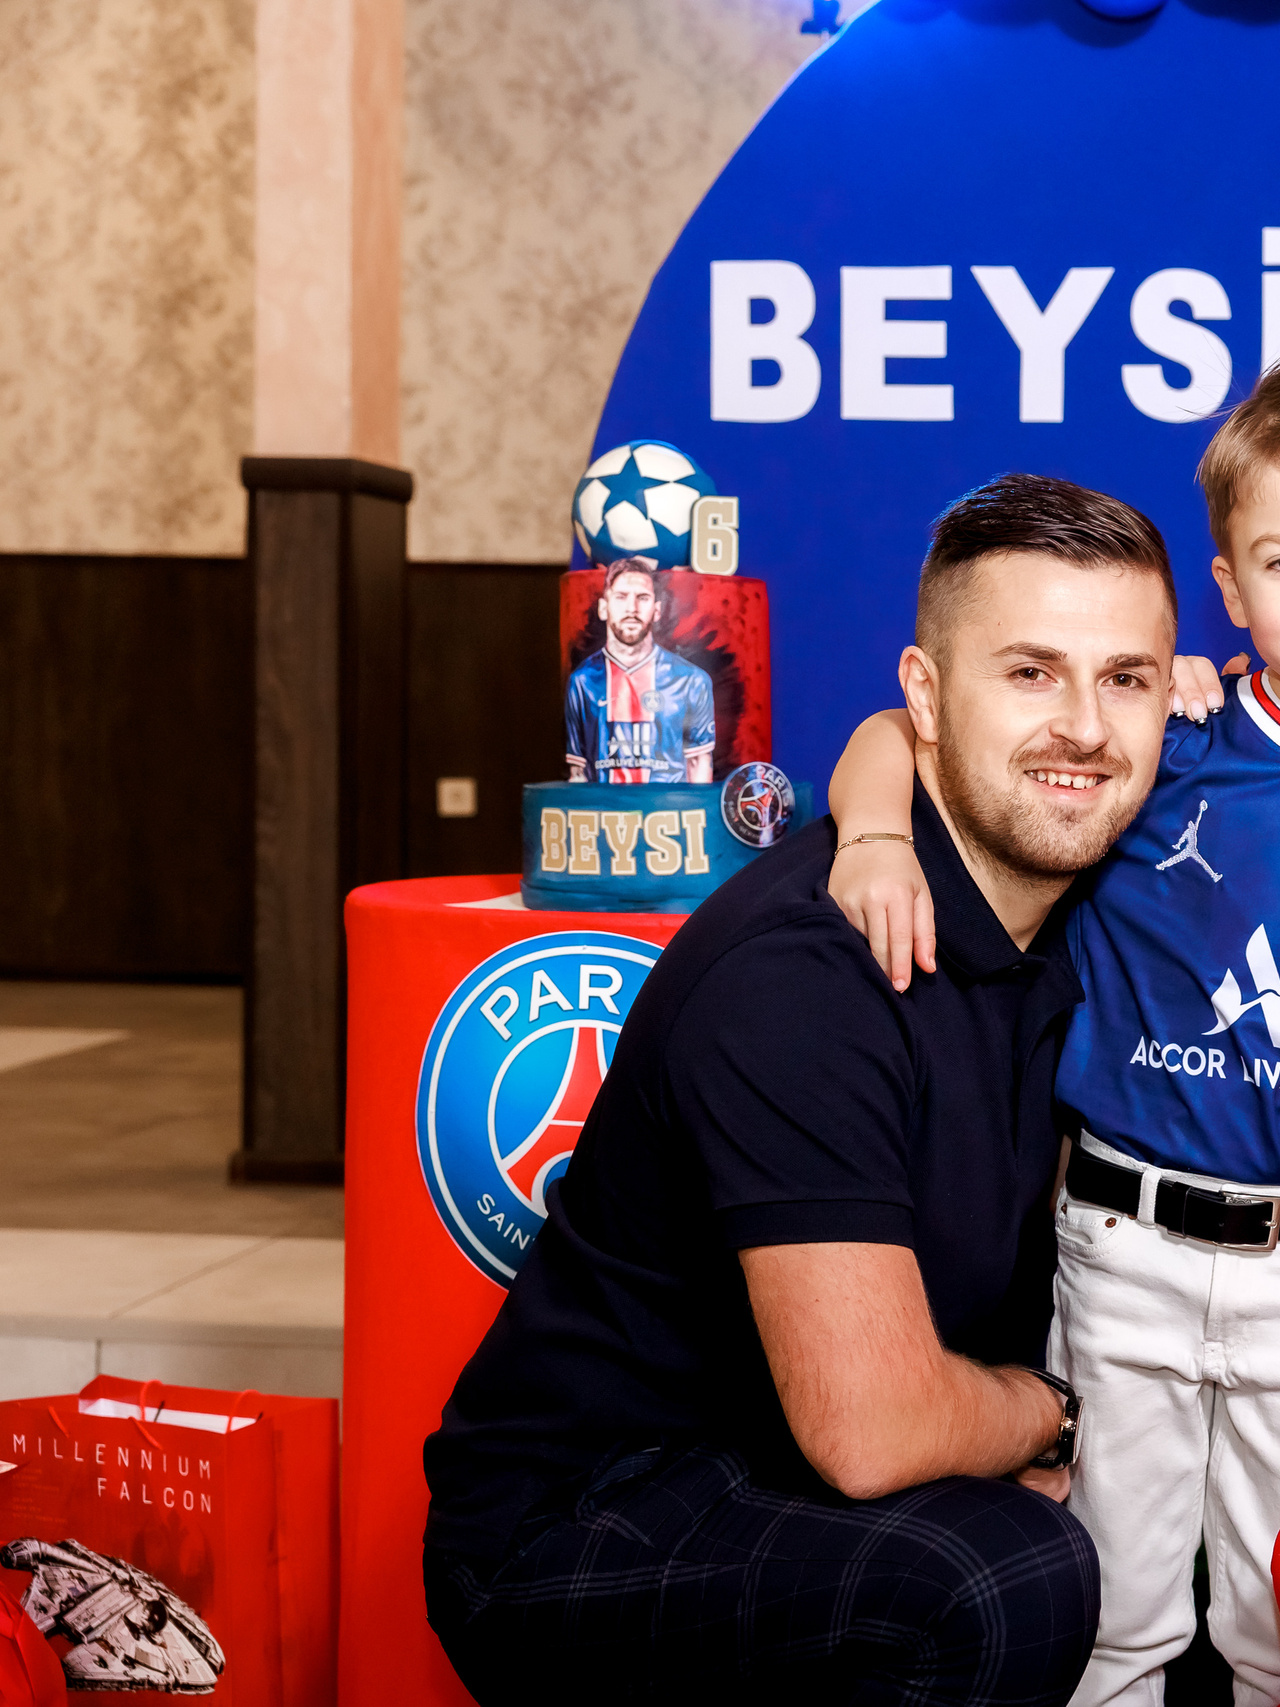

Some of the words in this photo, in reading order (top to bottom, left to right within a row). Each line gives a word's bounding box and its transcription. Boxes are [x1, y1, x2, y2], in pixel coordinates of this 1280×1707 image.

[690, 495, 740, 576] 6
[541, 807, 710, 876] BEYSI
[479, 964, 624, 1042] PAR
[1129, 1035, 1227, 1080] ACCOR
[476, 1193, 536, 1251] SAIN
[13, 1433, 211, 1480] MILLENNIUM
[97, 1477, 211, 1514] FALCON
